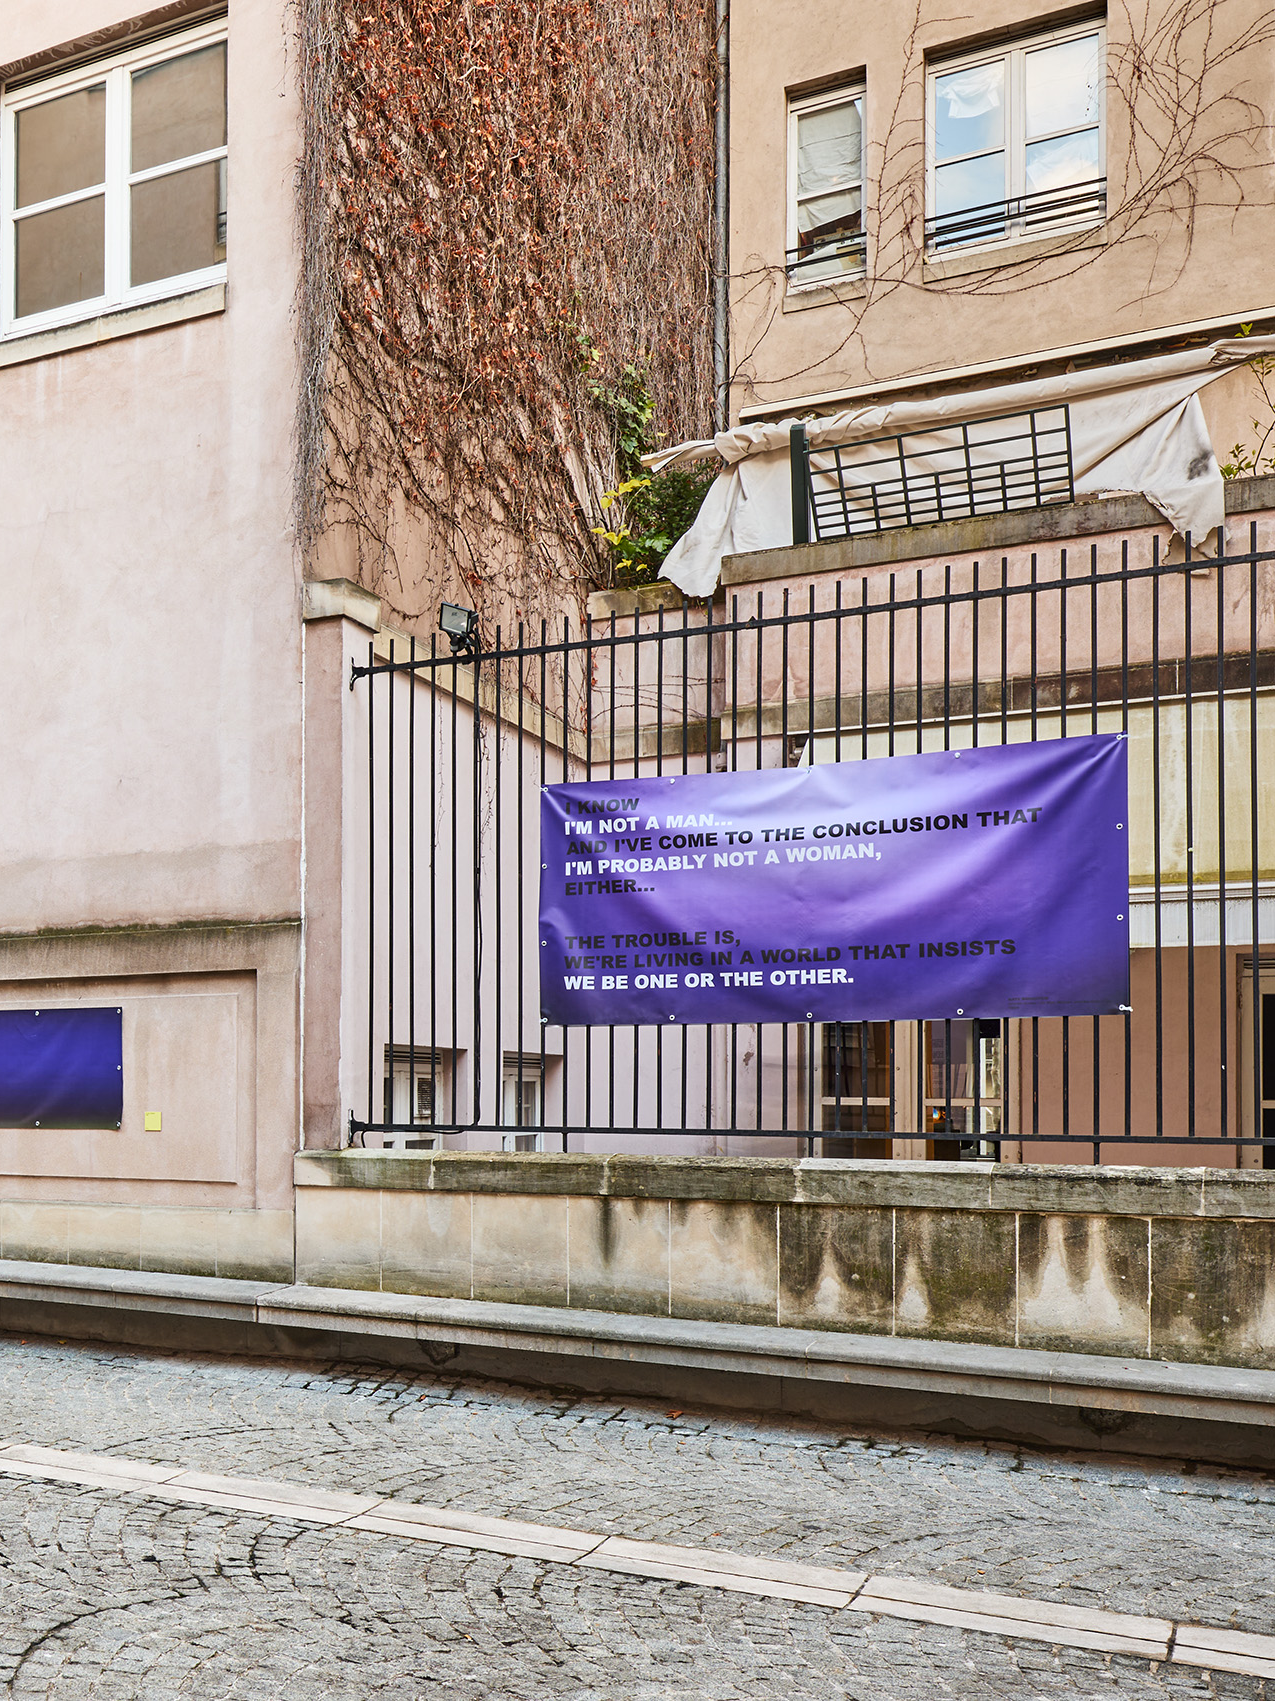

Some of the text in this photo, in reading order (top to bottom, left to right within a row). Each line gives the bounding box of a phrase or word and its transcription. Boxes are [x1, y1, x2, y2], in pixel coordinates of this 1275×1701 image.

[565, 798, 640, 815] I KNOW
[564, 814, 733, 835] I'M NOT A MAN...
[566, 807, 1043, 855] AND I'VE COME TO THE CONCLUSION THAT
[565, 842, 882, 876] I'M PROBABLY NOT A WOMAN,
[565, 879, 655, 896] EITHER...
[565, 930, 741, 949] THE TROUBLE IS,
[564, 939, 1017, 969] WE'RE LIVING IN A WORLD THAT INSISTS
[564, 968, 854, 990] WE BE ONE OR THE OTHER.
